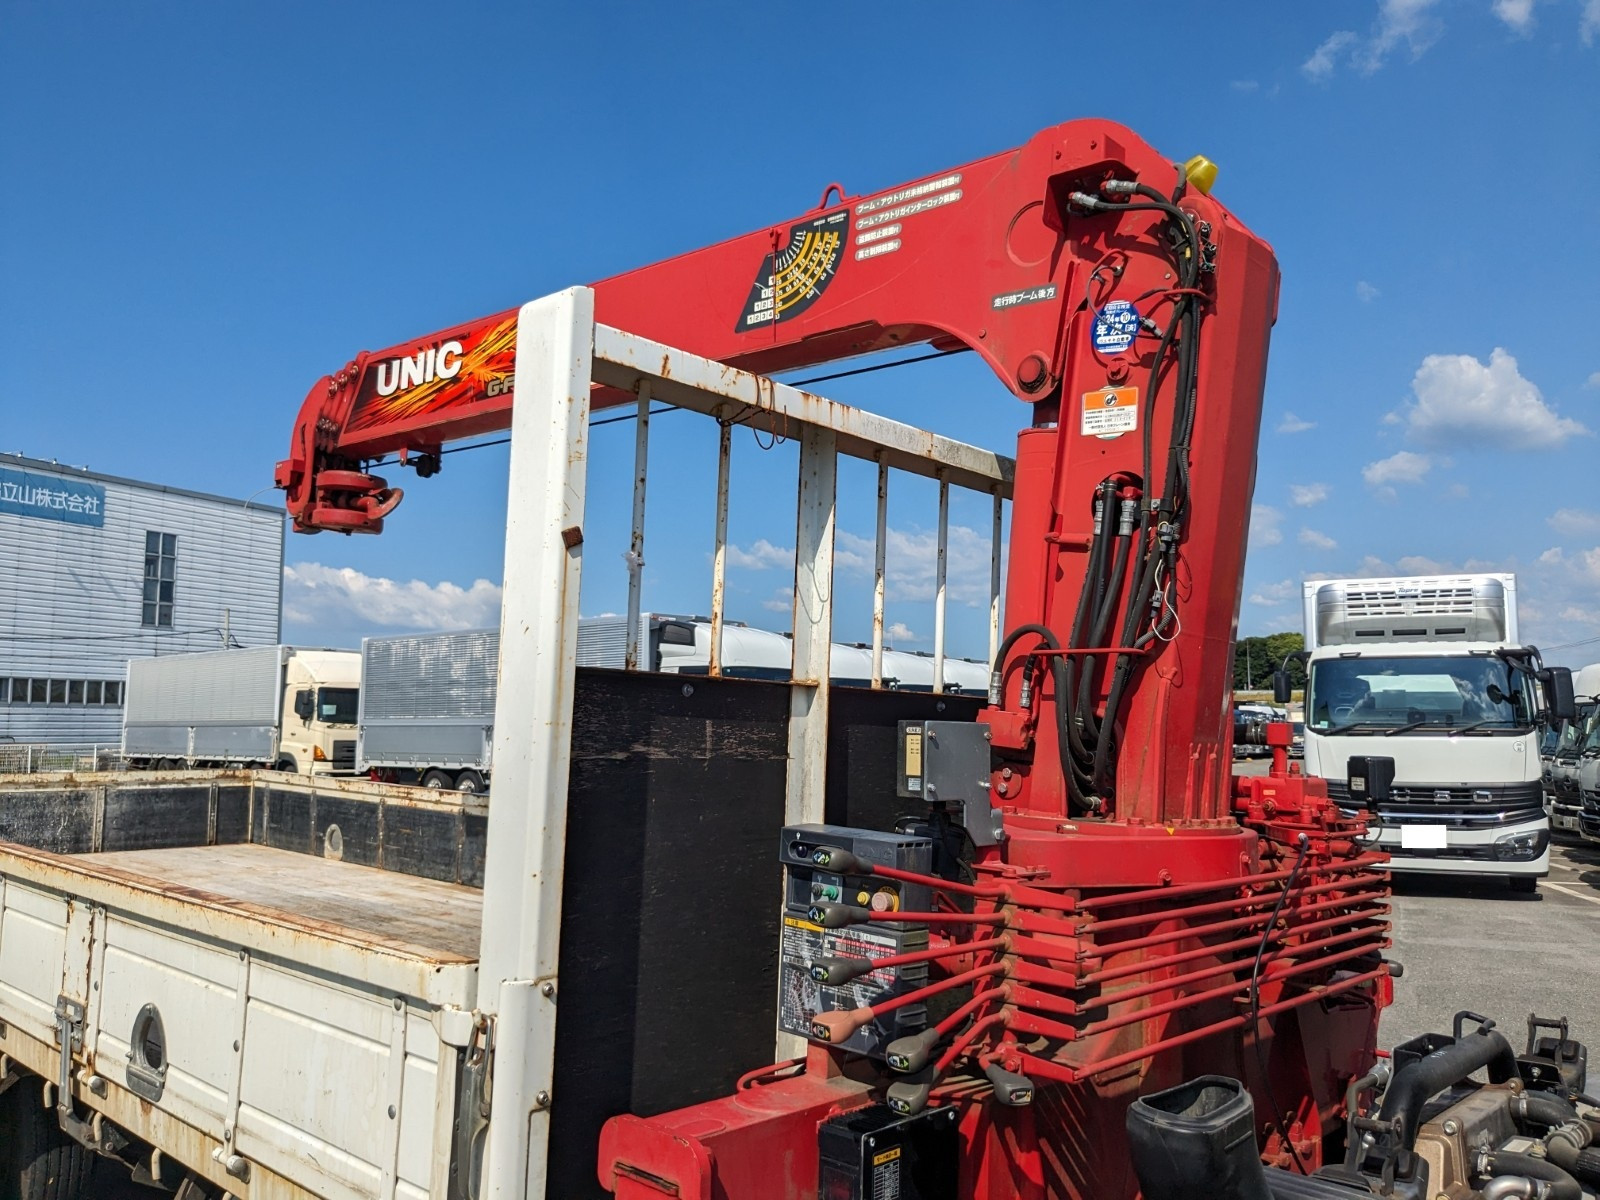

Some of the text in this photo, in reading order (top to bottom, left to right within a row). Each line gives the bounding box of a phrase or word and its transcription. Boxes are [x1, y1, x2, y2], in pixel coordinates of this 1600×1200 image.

[376, 340, 463, 396] UNIC
[487, 374, 515, 397] G-F
[0, 481, 100, 516] 立山株式会社
